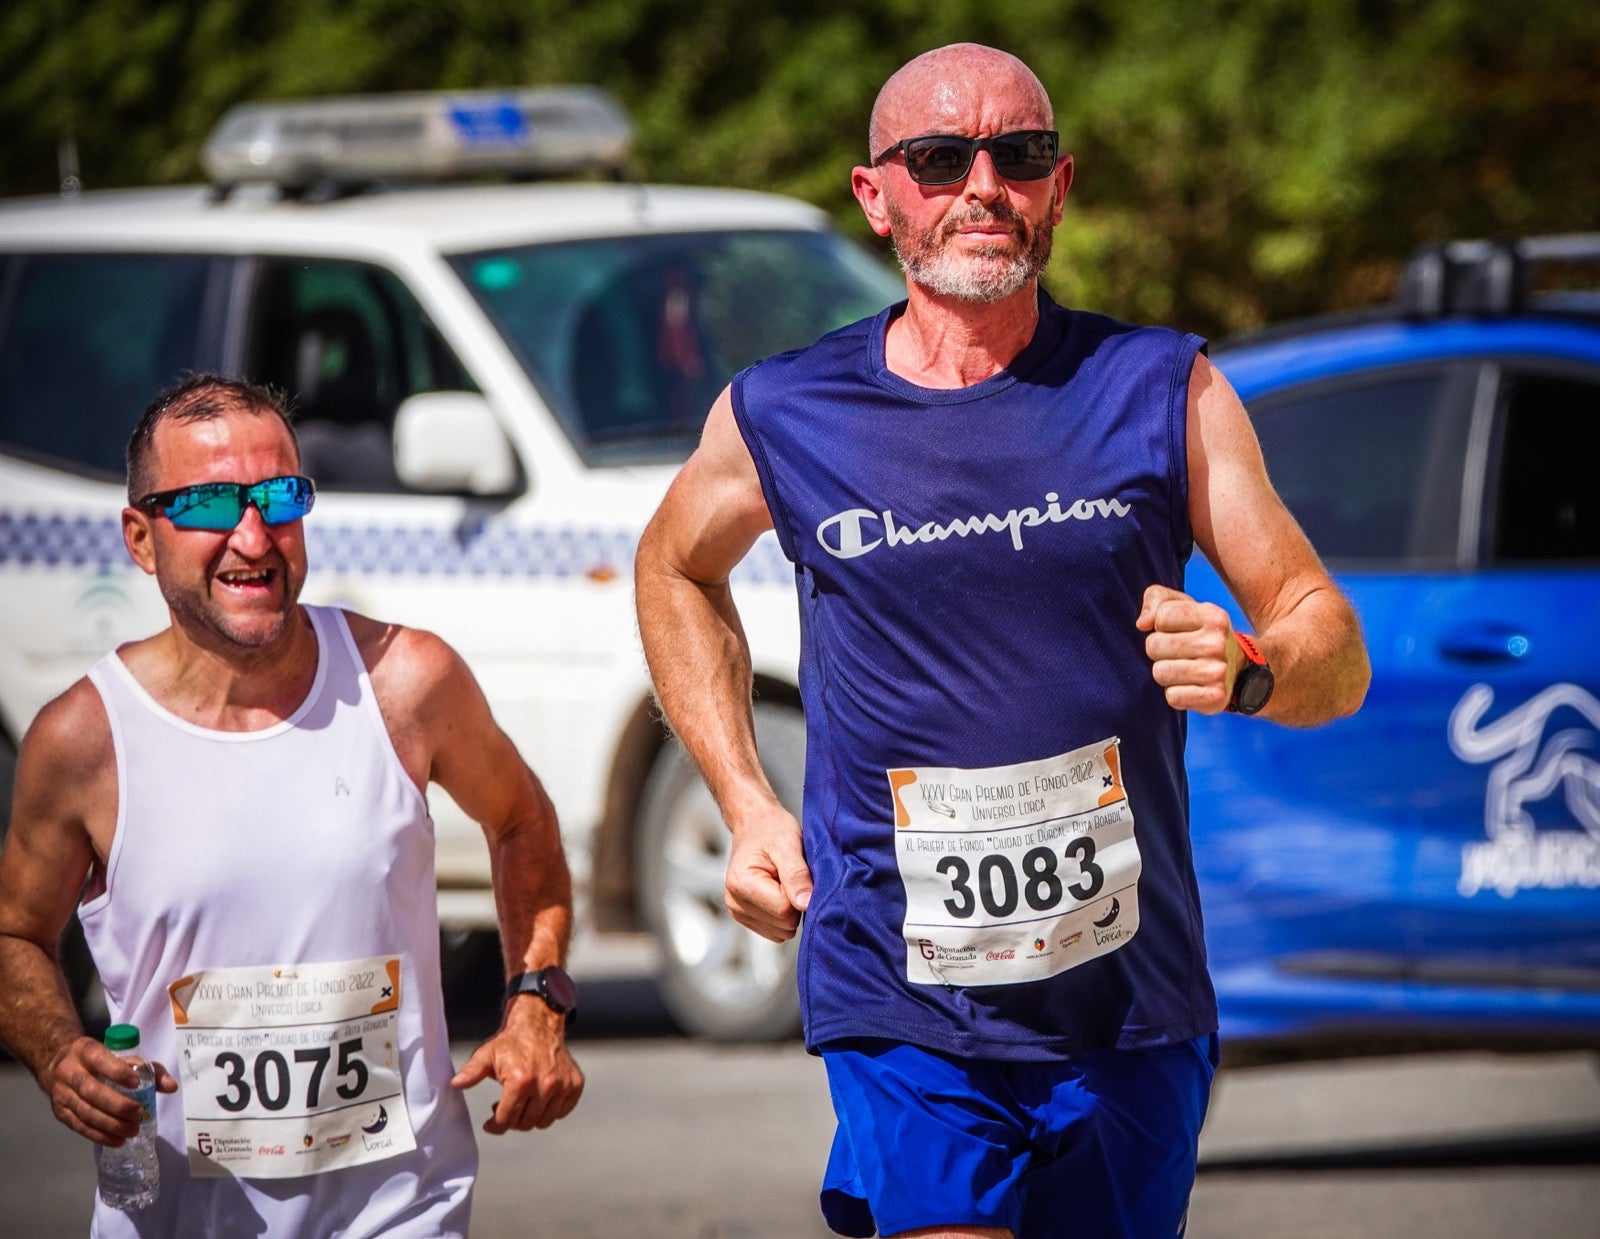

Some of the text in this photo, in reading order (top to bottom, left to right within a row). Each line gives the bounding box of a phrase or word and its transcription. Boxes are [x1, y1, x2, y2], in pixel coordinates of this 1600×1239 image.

[817, 492, 1131, 559] Champion
[920, 783, 945, 801] XXXV
[1070, 760, 1094, 785] 2022
[936, 836, 1104, 918] 3083
[935, 945, 976, 954] Diputación
[945, 953, 977, 961] Granada
[199, 983, 222, 1000] XXXV
[349, 971, 375, 991] 2022
[215, 1037, 369, 1112] 3075
